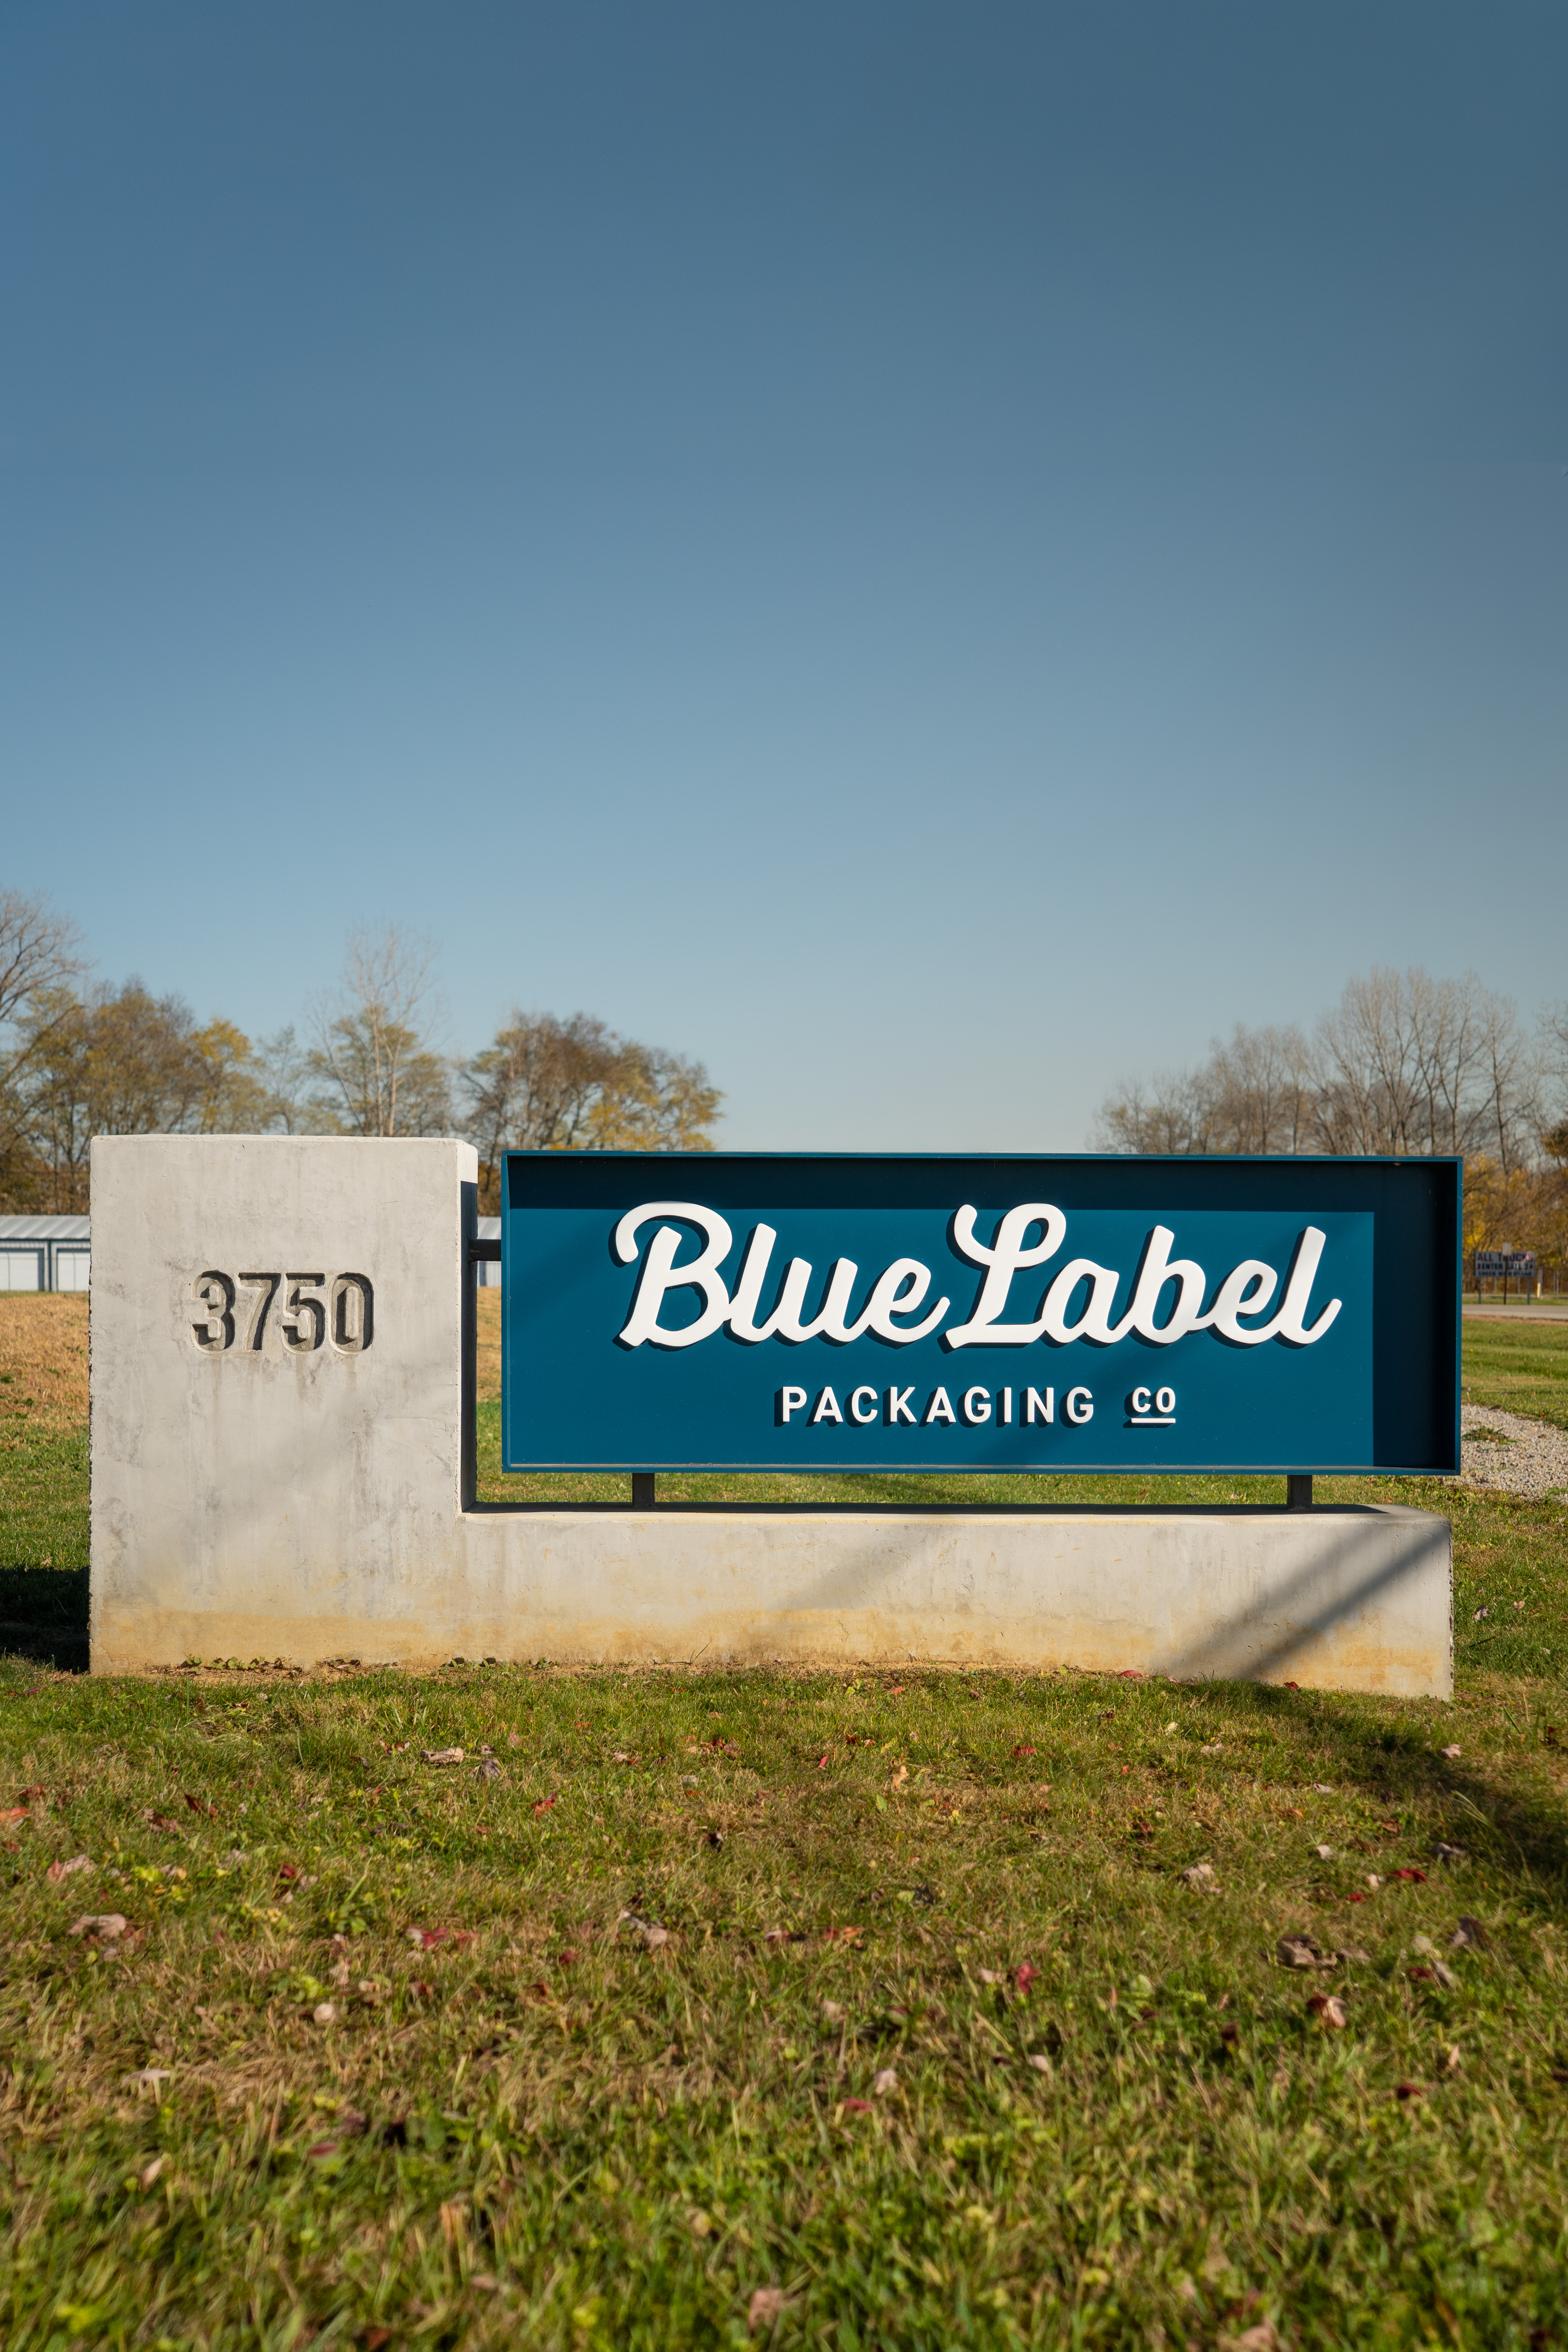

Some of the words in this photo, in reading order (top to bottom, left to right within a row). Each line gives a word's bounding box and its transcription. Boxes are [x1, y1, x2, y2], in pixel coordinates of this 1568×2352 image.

[615, 1203, 951, 1347] Blue
[946, 1203, 1342, 1348] Label
[1477, 1252, 1492, 1261] ALL
[191, 1269, 374, 1354] 3750
[782, 1386, 1094, 1423] PACKAGING
[1132, 1387, 1176, 1414] CO
